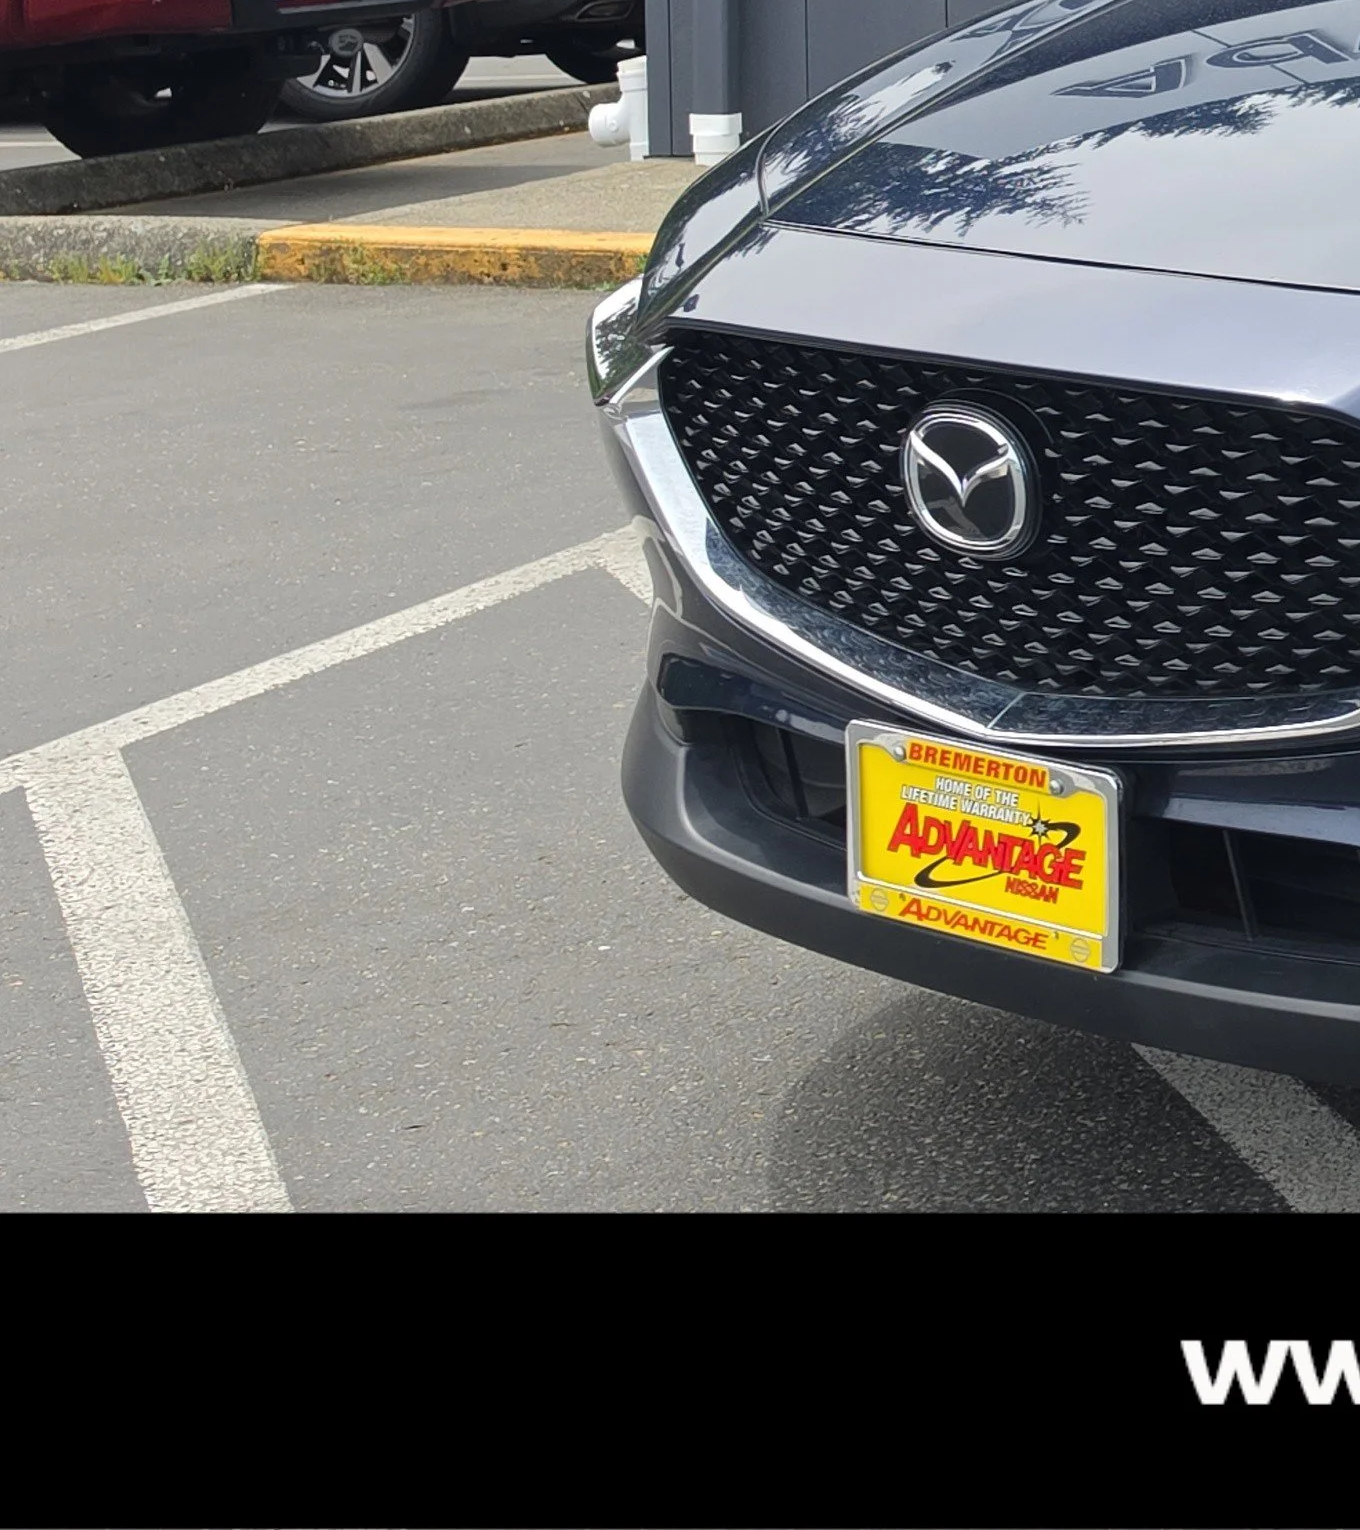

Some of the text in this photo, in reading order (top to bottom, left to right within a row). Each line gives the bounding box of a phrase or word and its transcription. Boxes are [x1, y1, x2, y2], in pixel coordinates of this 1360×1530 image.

[908, 742, 1047, 788] BREMERTON
[901, 785, 1032, 827] LIFETIME WARRANTY
[935, 776, 1019, 807] HOME OF THE
[887, 802, 1087, 890] ADVANTAGE
[1004, 876, 1060, 905] NISSAN
[898, 896, 1050, 950] ADVANTAGE
